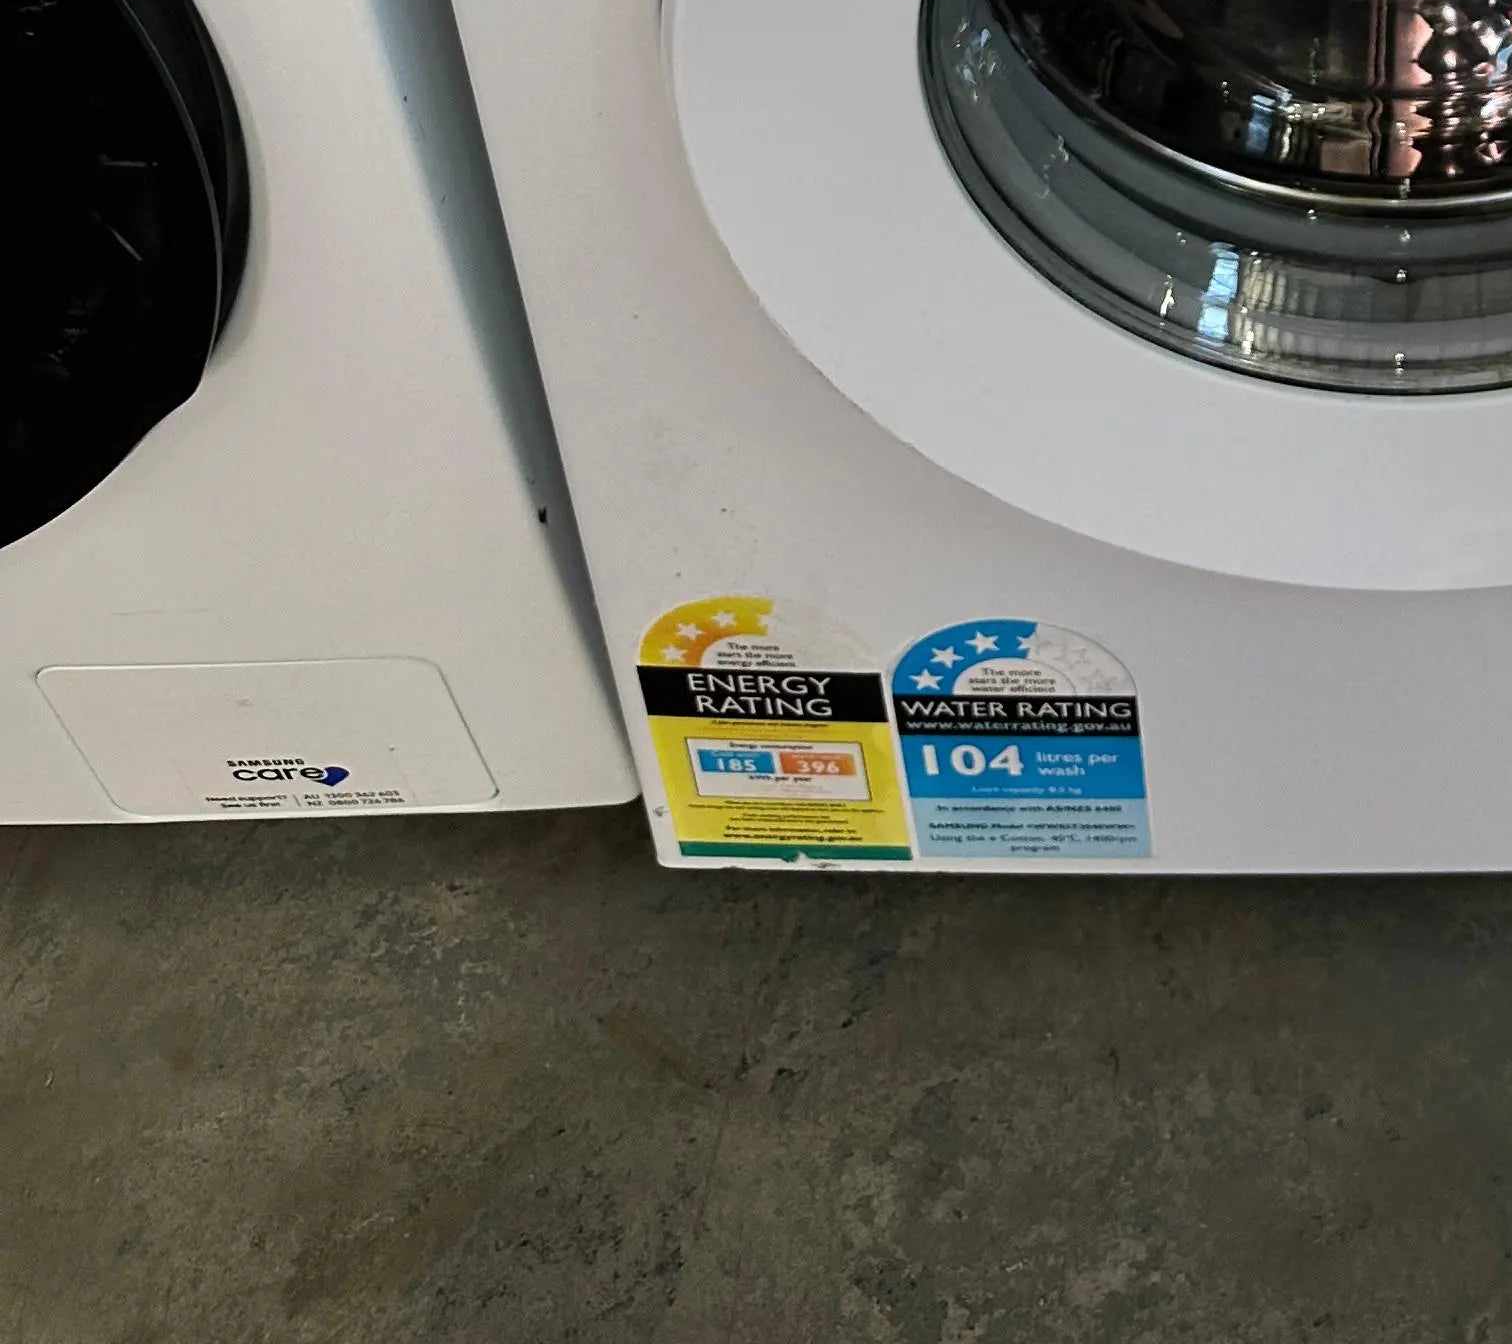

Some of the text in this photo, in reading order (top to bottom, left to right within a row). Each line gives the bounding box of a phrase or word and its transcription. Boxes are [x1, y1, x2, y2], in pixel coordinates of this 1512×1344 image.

[982, 667, 1005, 676] The
[687, 673, 831, 695] ENERGY
[695, 695, 833, 716] RATING
[901, 701, 1132, 718] WATER RATING
[906, 720, 1132, 732] www.waterrating.gov.au
[226, 758, 305, 767] SAMSUNG
[717, 756, 840, 773] 185 396
[922, 744, 1024, 776] 104
[1035, 751, 1119, 765] litres per
[233, 766, 324, 781] care
[1038, 765, 1086, 776] wash
